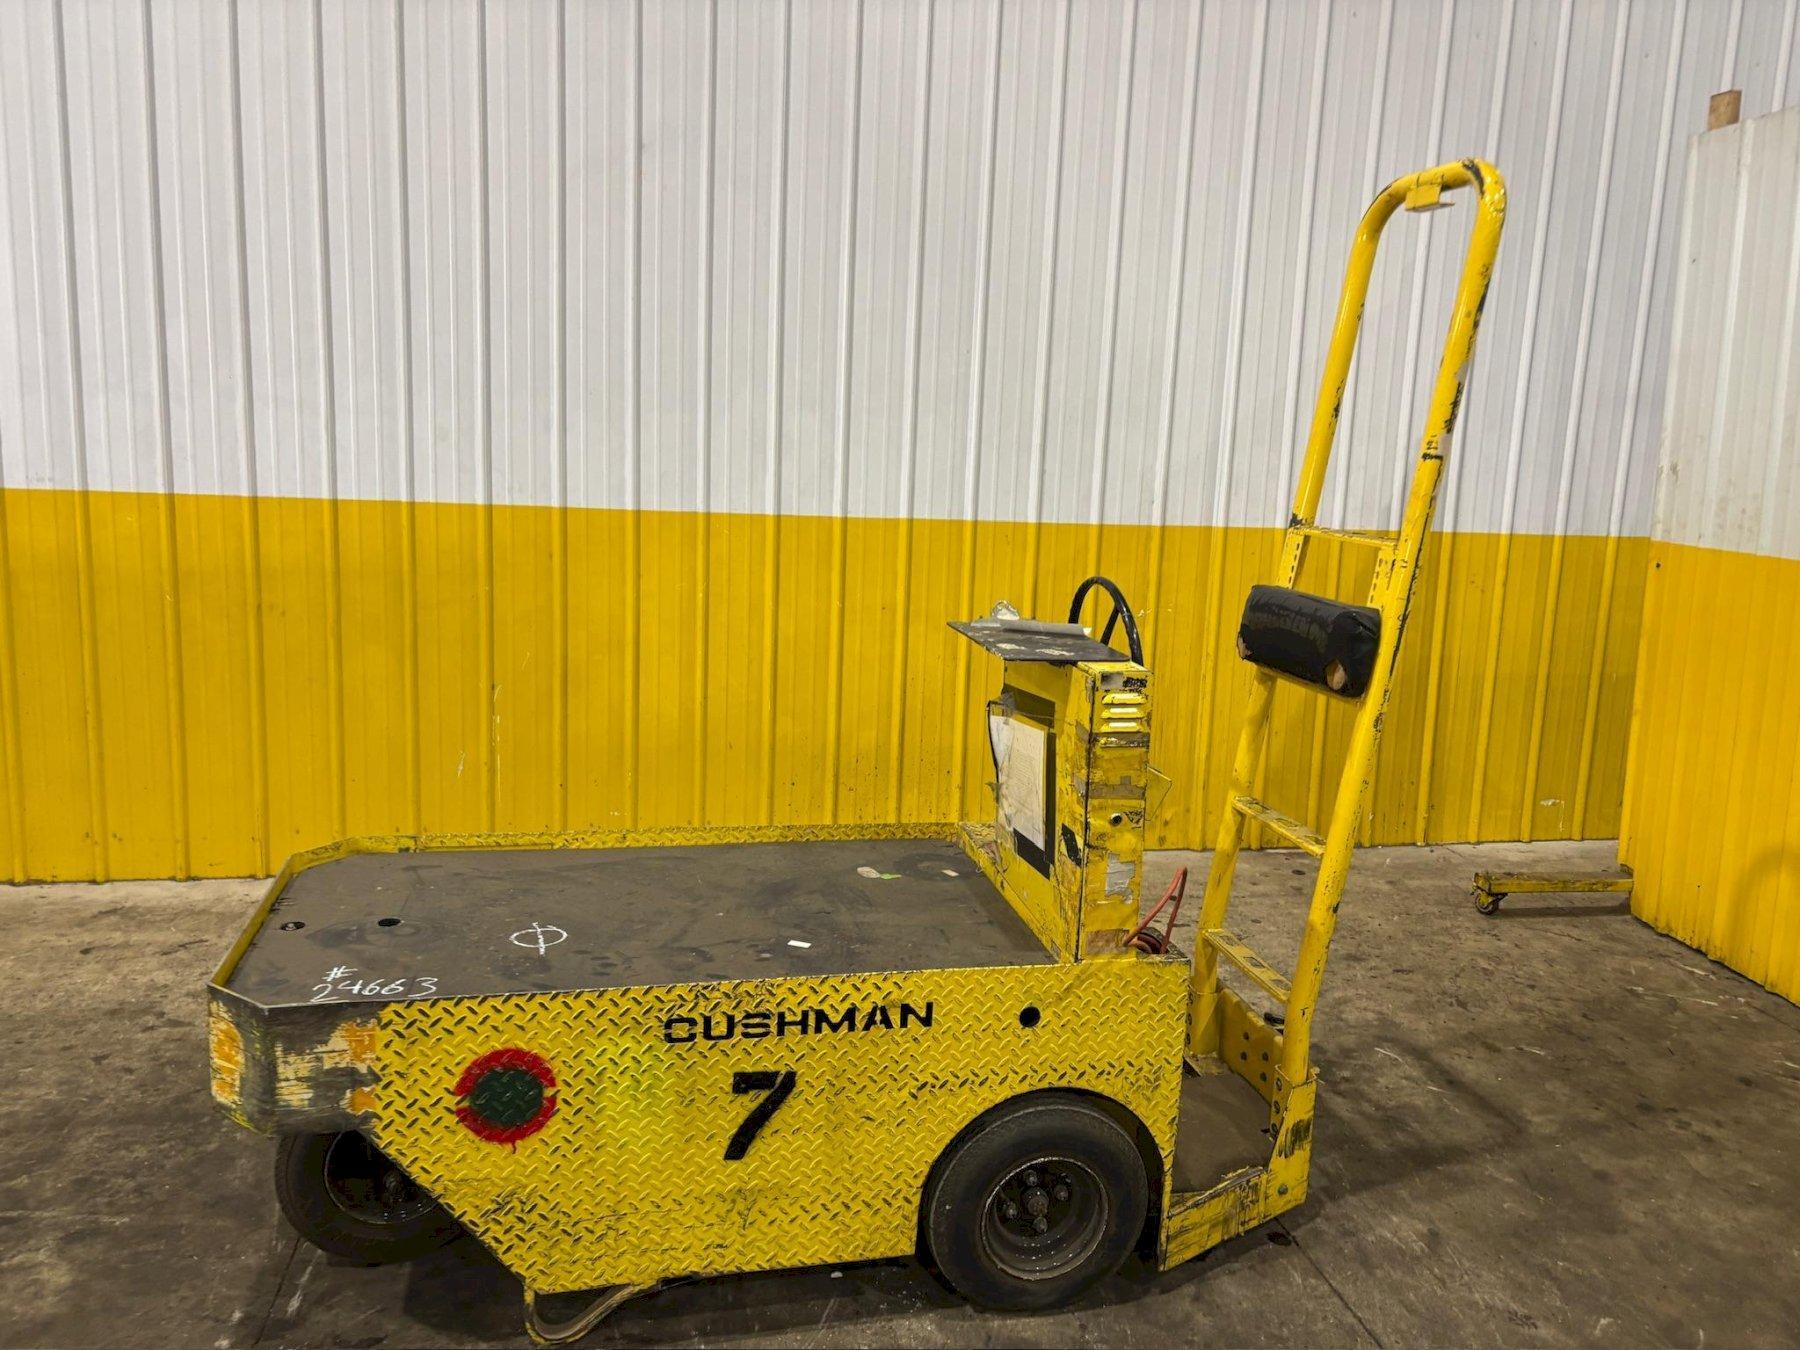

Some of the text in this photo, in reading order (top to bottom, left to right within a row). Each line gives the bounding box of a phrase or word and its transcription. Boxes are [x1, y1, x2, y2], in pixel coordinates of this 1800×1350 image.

[310, 977, 439, 1003] 24663
[321, 965, 359, 982] #
[664, 1002, 934, 1043] CUSHMAN
[724, 1070, 797, 1161] 7
